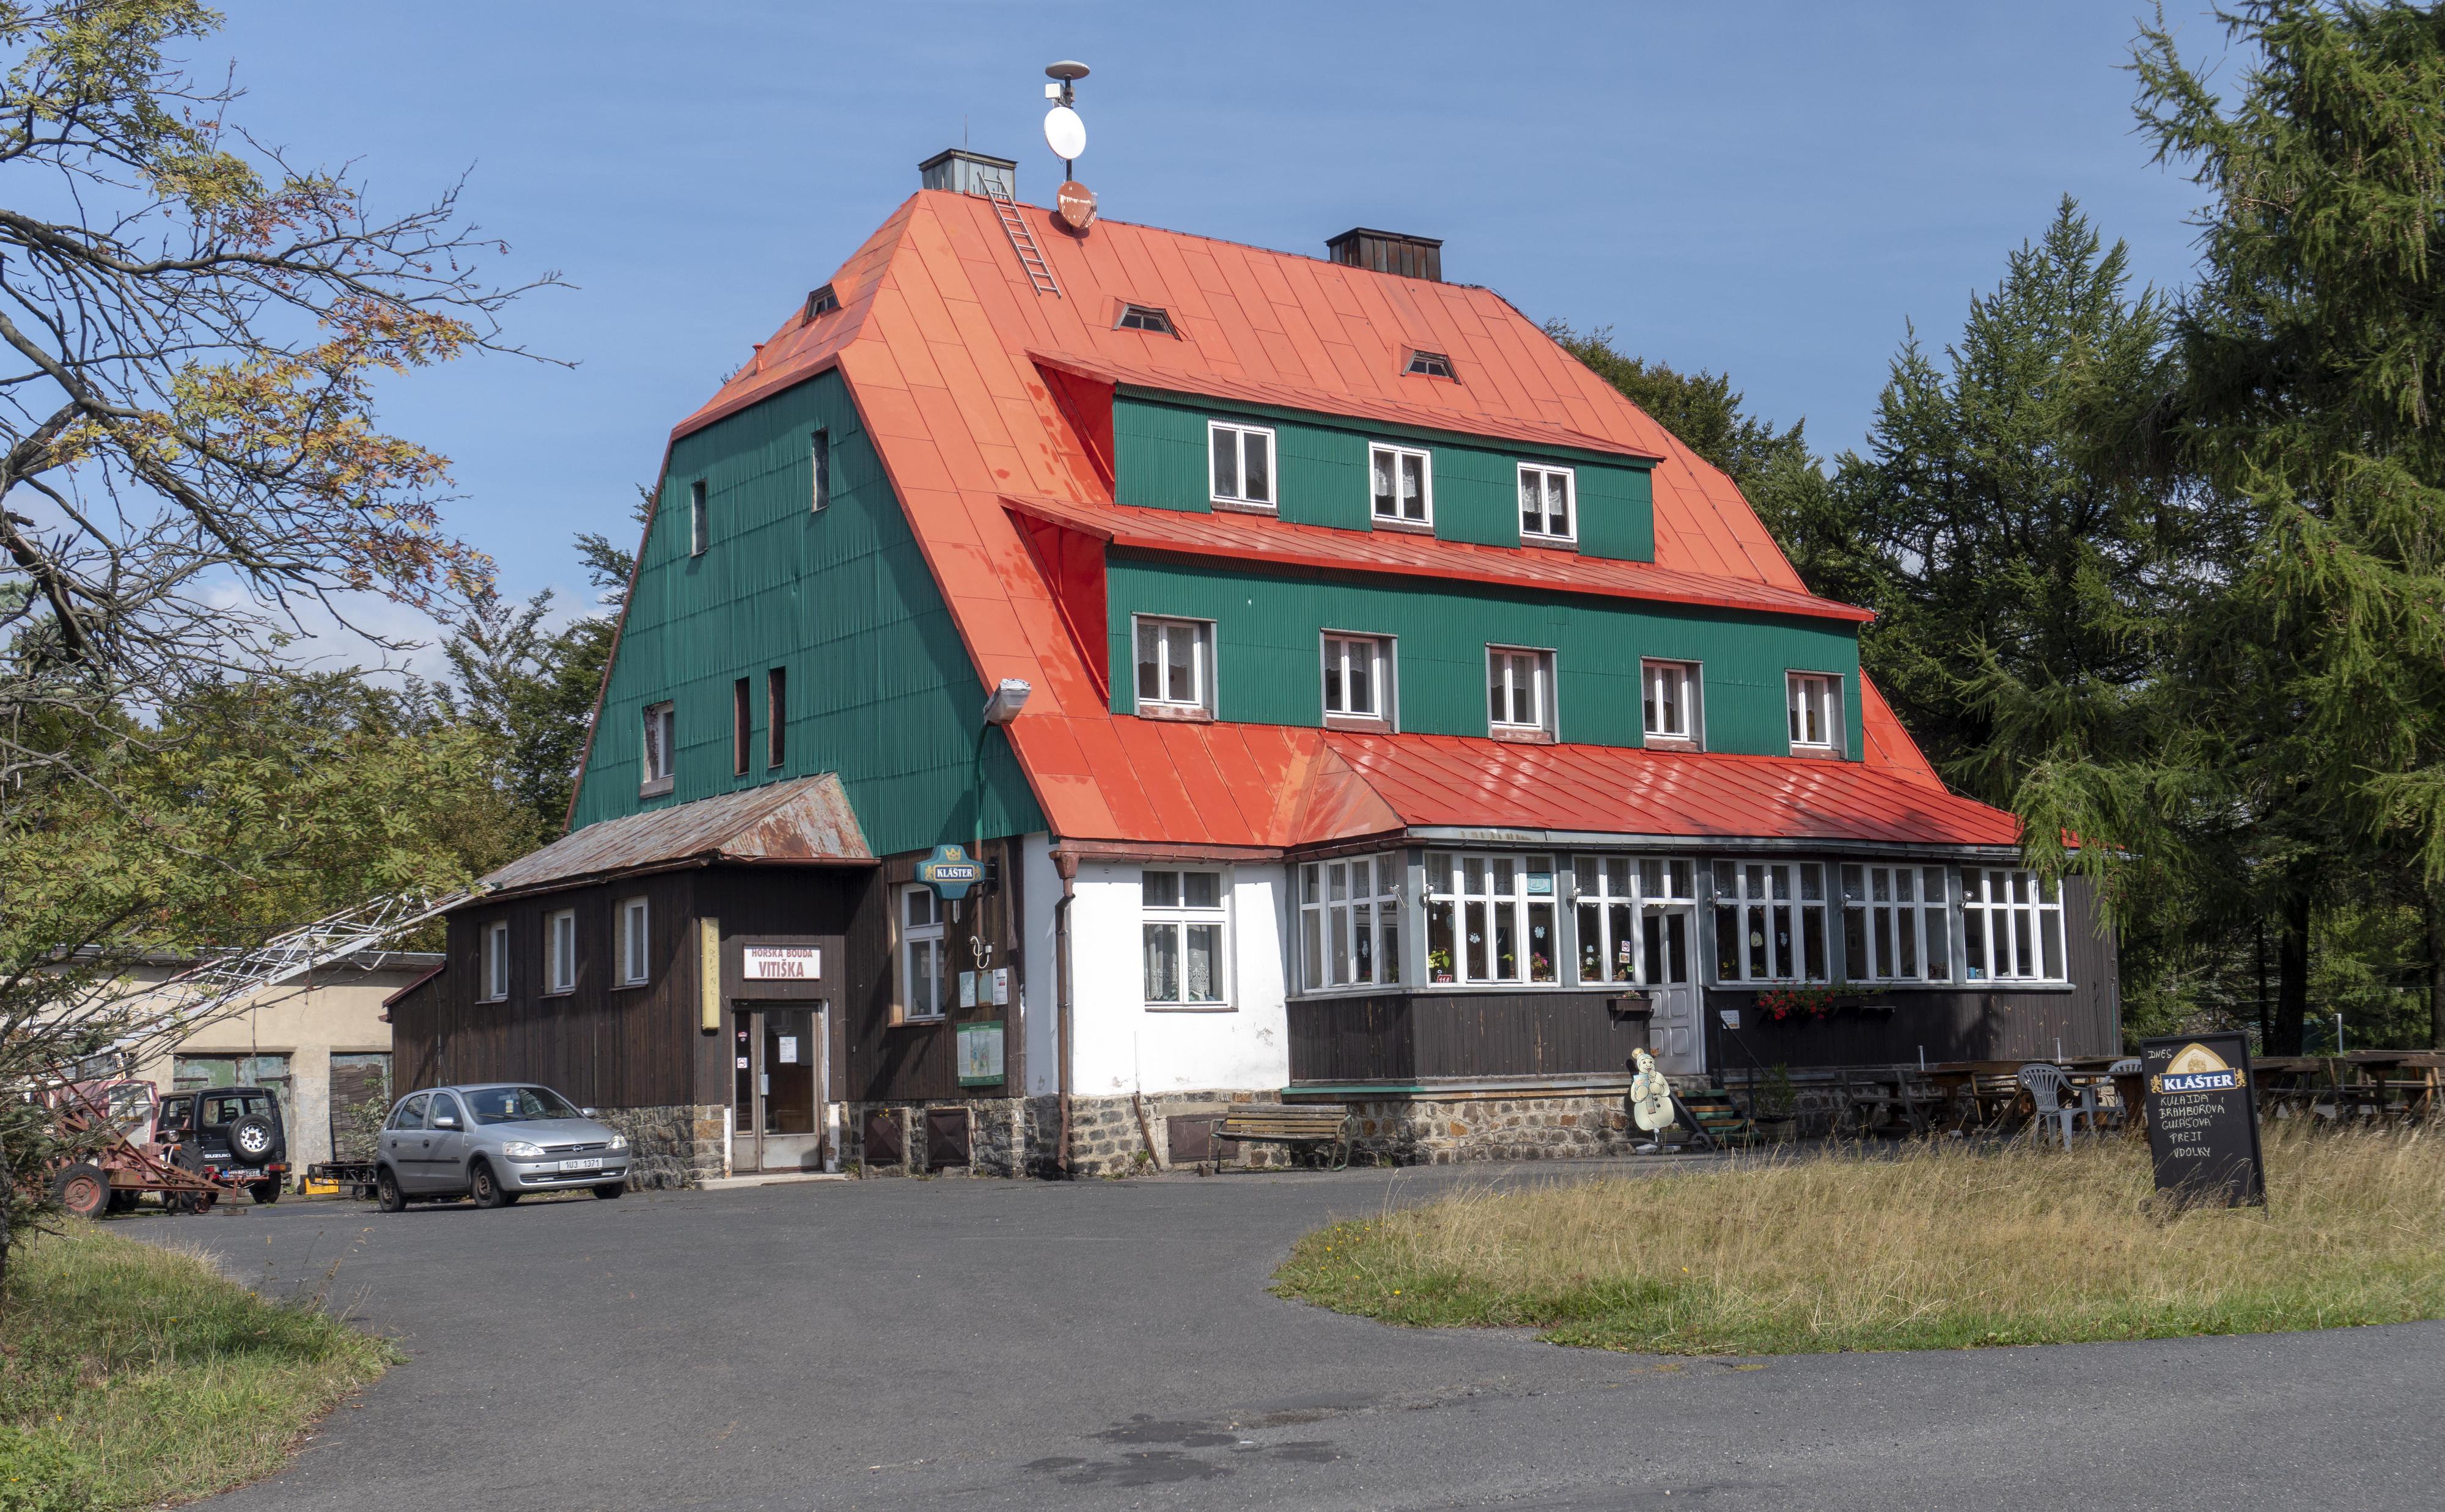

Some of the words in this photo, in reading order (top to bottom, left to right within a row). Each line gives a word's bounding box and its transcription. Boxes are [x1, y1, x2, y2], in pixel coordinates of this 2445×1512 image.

[937, 867, 972, 878] KLÁŠTER
[786, 949, 813, 958] BOUDA
[759, 958, 804, 977] VITIŠKA
[2147, 1049, 2172, 1059] DNES
[2164, 1074, 2234, 1091] KLÁŠTER
[2174, 1147, 2211, 1158] VDOLKY
[565, 1161, 578, 1169] 1U3
[583, 1159, 600, 1167] 1371
